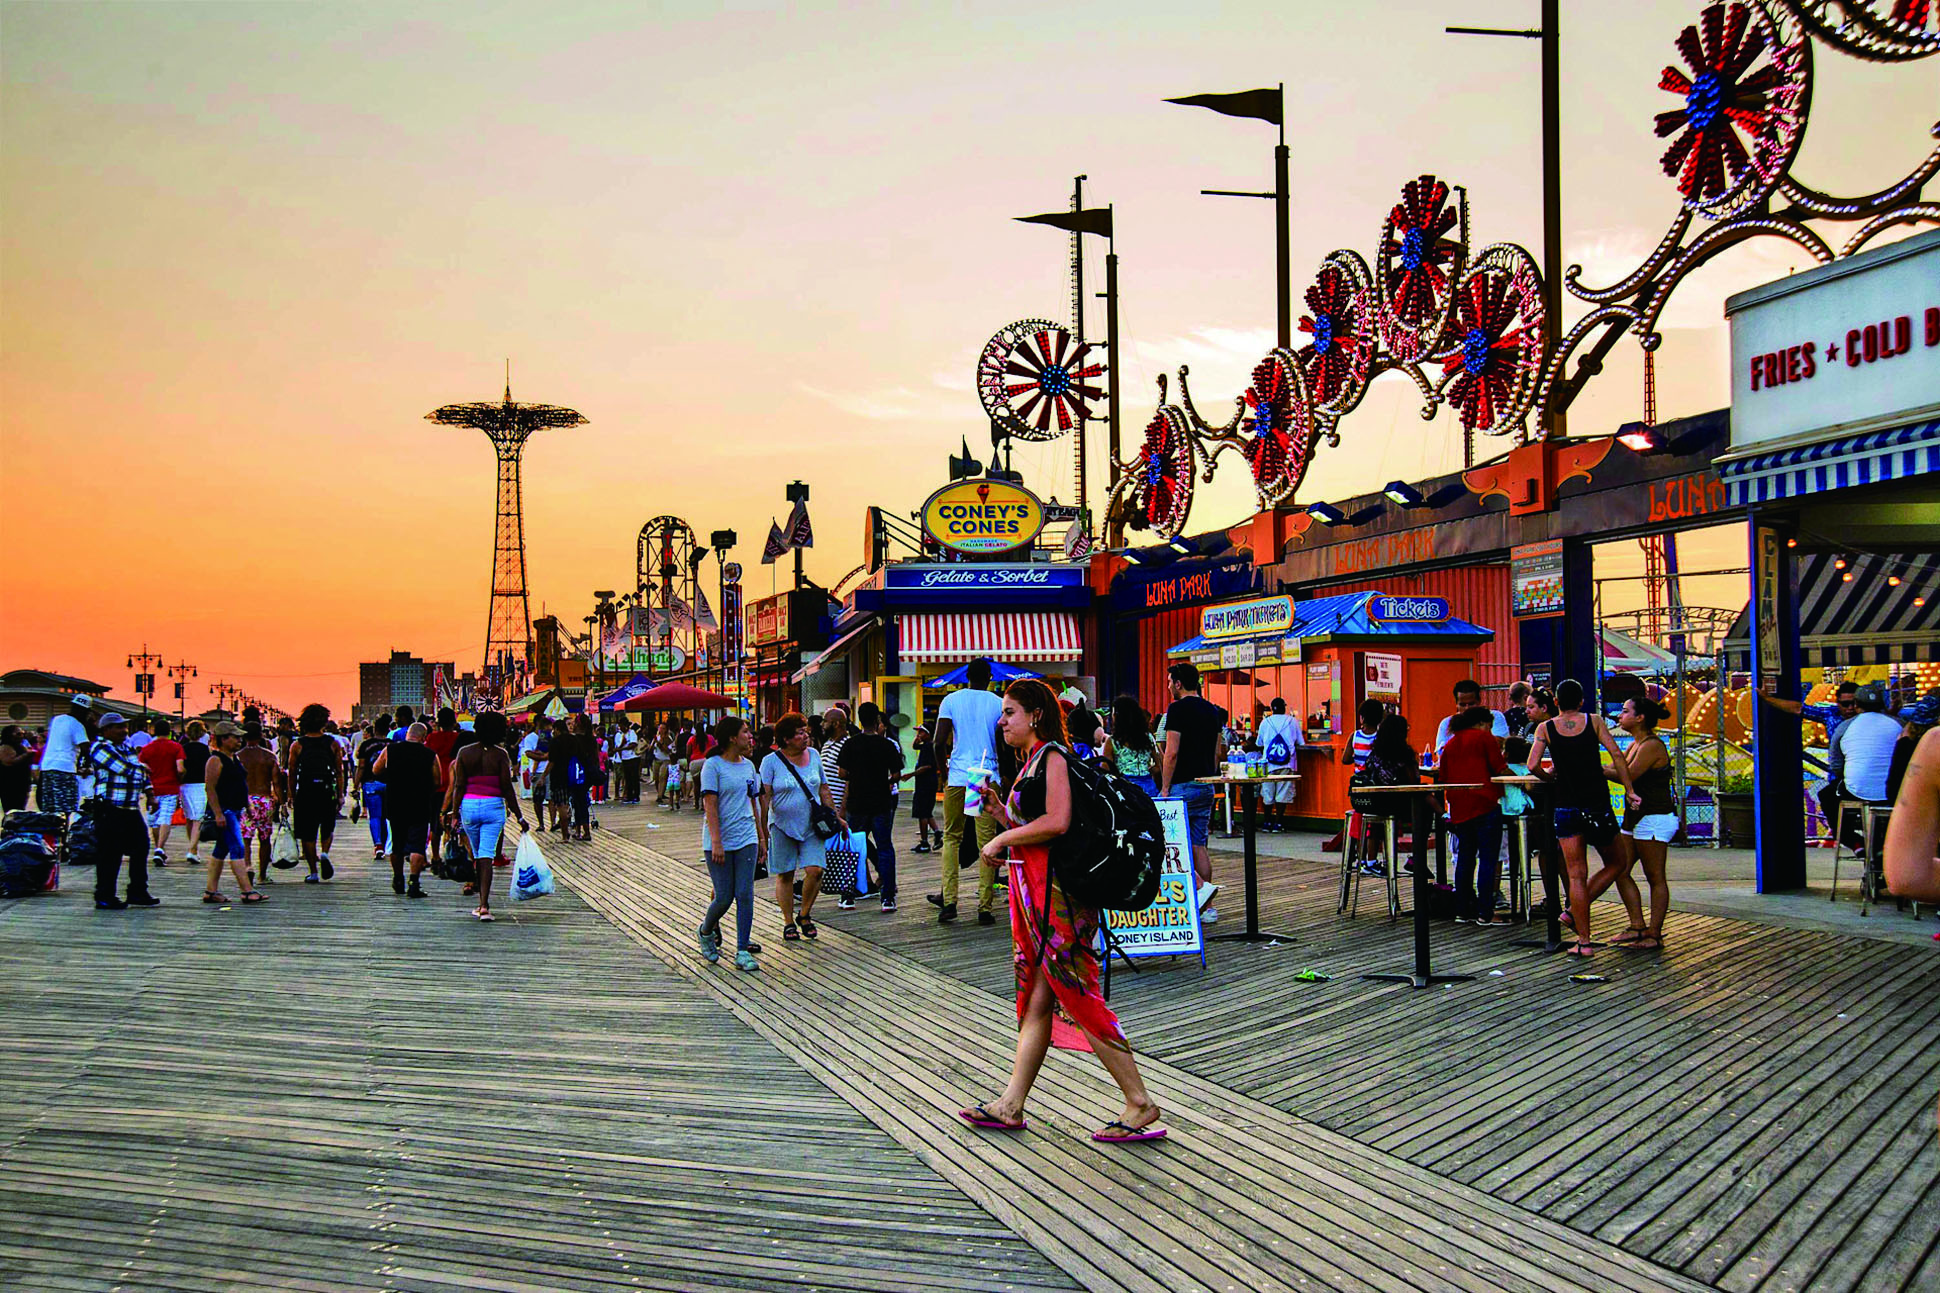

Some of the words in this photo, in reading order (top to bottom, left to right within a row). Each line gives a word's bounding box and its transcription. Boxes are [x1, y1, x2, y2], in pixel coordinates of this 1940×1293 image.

[1750, 341, 1816, 391] FRIES
[1845, 315, 1912, 367] COLD
[939, 505, 1029, 519] CONEY'S
[948, 520, 1019, 534] CONES
[1334, 537, 1380, 575] LUNA
[1387, 526, 1436, 566] PARK
[921, 570, 976, 586] Gelato
[978, 573, 989, 582] &
[991, 569, 1050, 583] Sorbet
[1146, 578, 1176, 607] LUNA
[1180, 572, 1212, 601] PARK
[1204, 610, 1225, 632] LUNA
[1227, 608, 1250, 630] PARK
[1250, 603, 1288, 625] TICKETS
[1380, 597, 1440, 619] Tickets
[1160, 808, 1179, 821] Best
[1108, 907, 1191, 929] DAUGHTER
[1150, 931, 1194, 943] ISLAND
